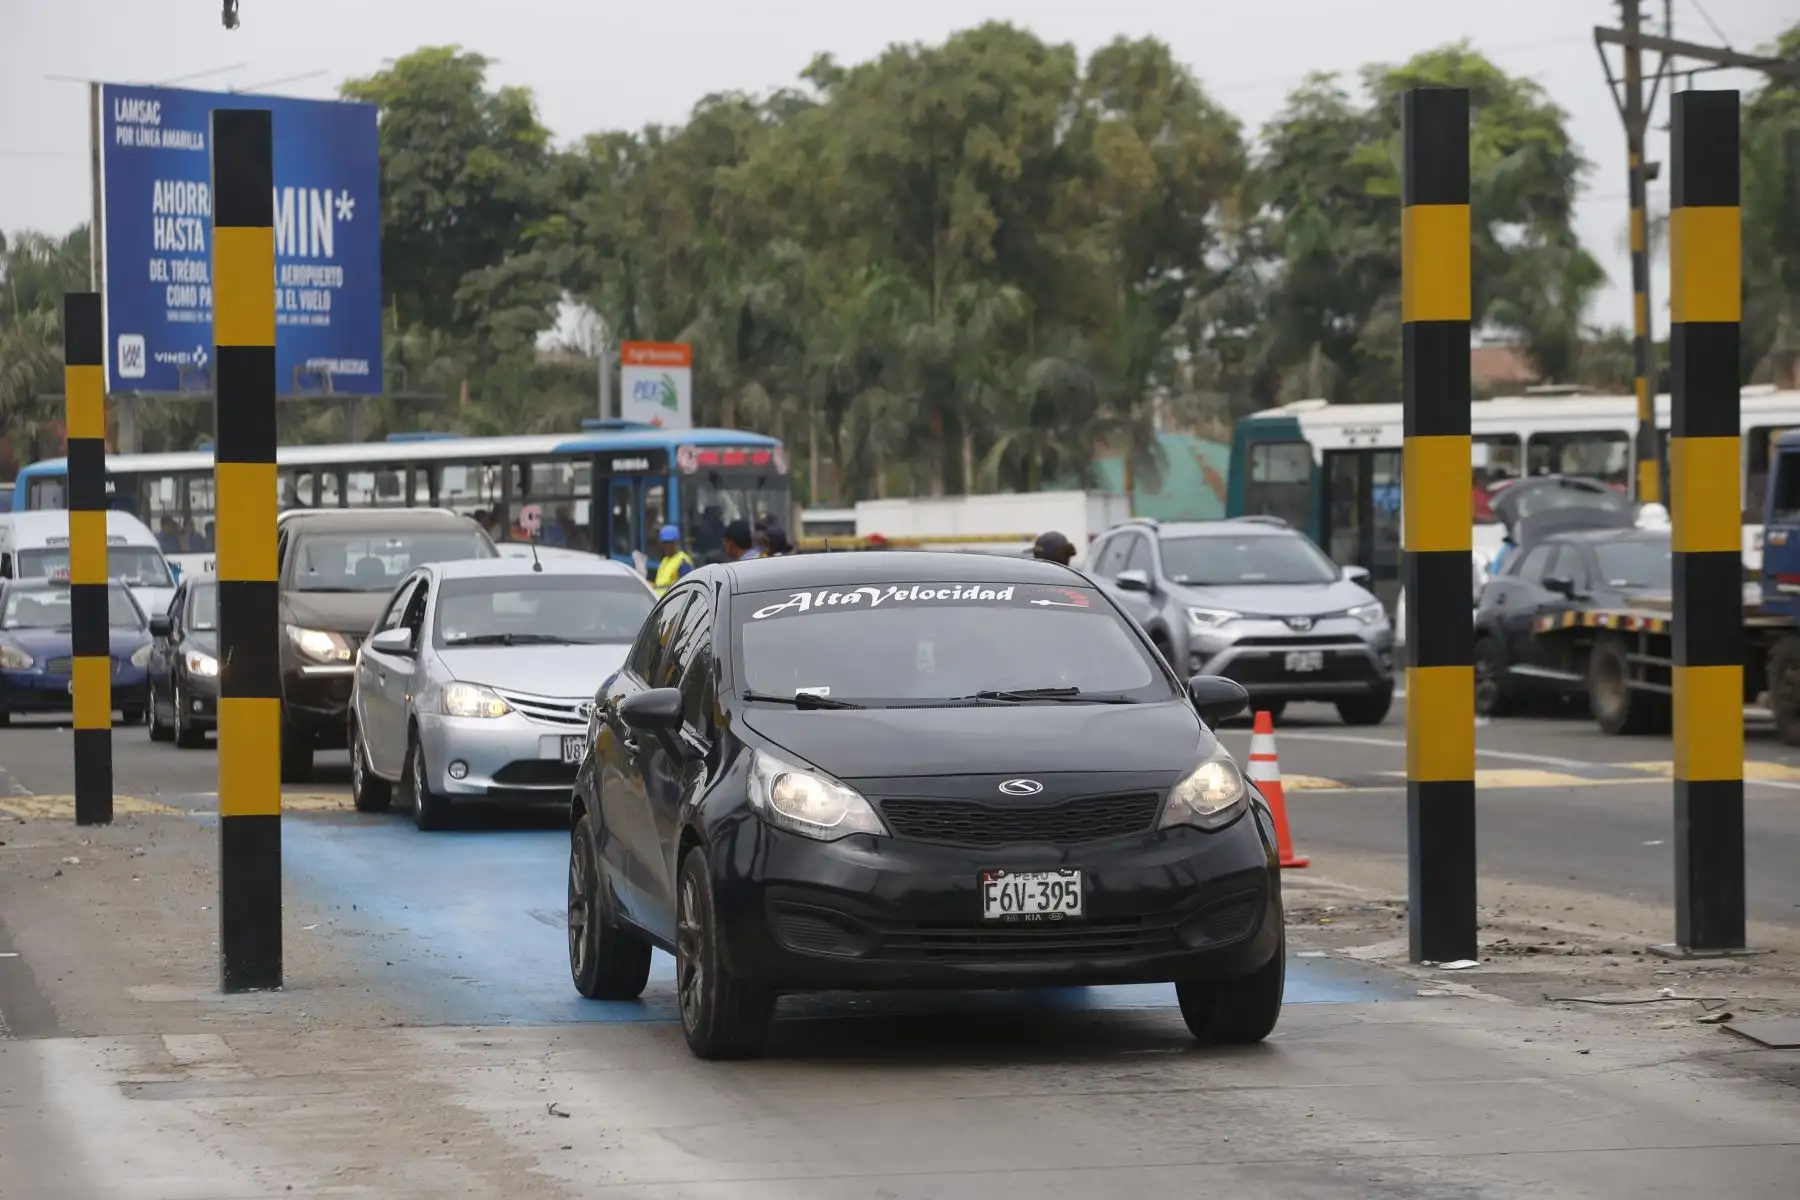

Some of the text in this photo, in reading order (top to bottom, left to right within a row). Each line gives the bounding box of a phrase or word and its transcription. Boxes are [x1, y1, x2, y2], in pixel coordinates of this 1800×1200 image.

[115, 97, 161, 126] LAMSAC
[116, 126, 134, 146] POR
[162, 129, 204, 150] AMARILLA
[152, 180, 211, 216] AHORR
[153, 216, 205, 252] HASTA
[149, 258, 169, 282] DEL
[281, 264, 343, 288] AEROPUERTO
[166, 284, 197, 308] COMO
[285, 288, 298, 311] EL
[299, 289, 331, 312] VUELO
[984, 881, 1079, 912] F6V-395
